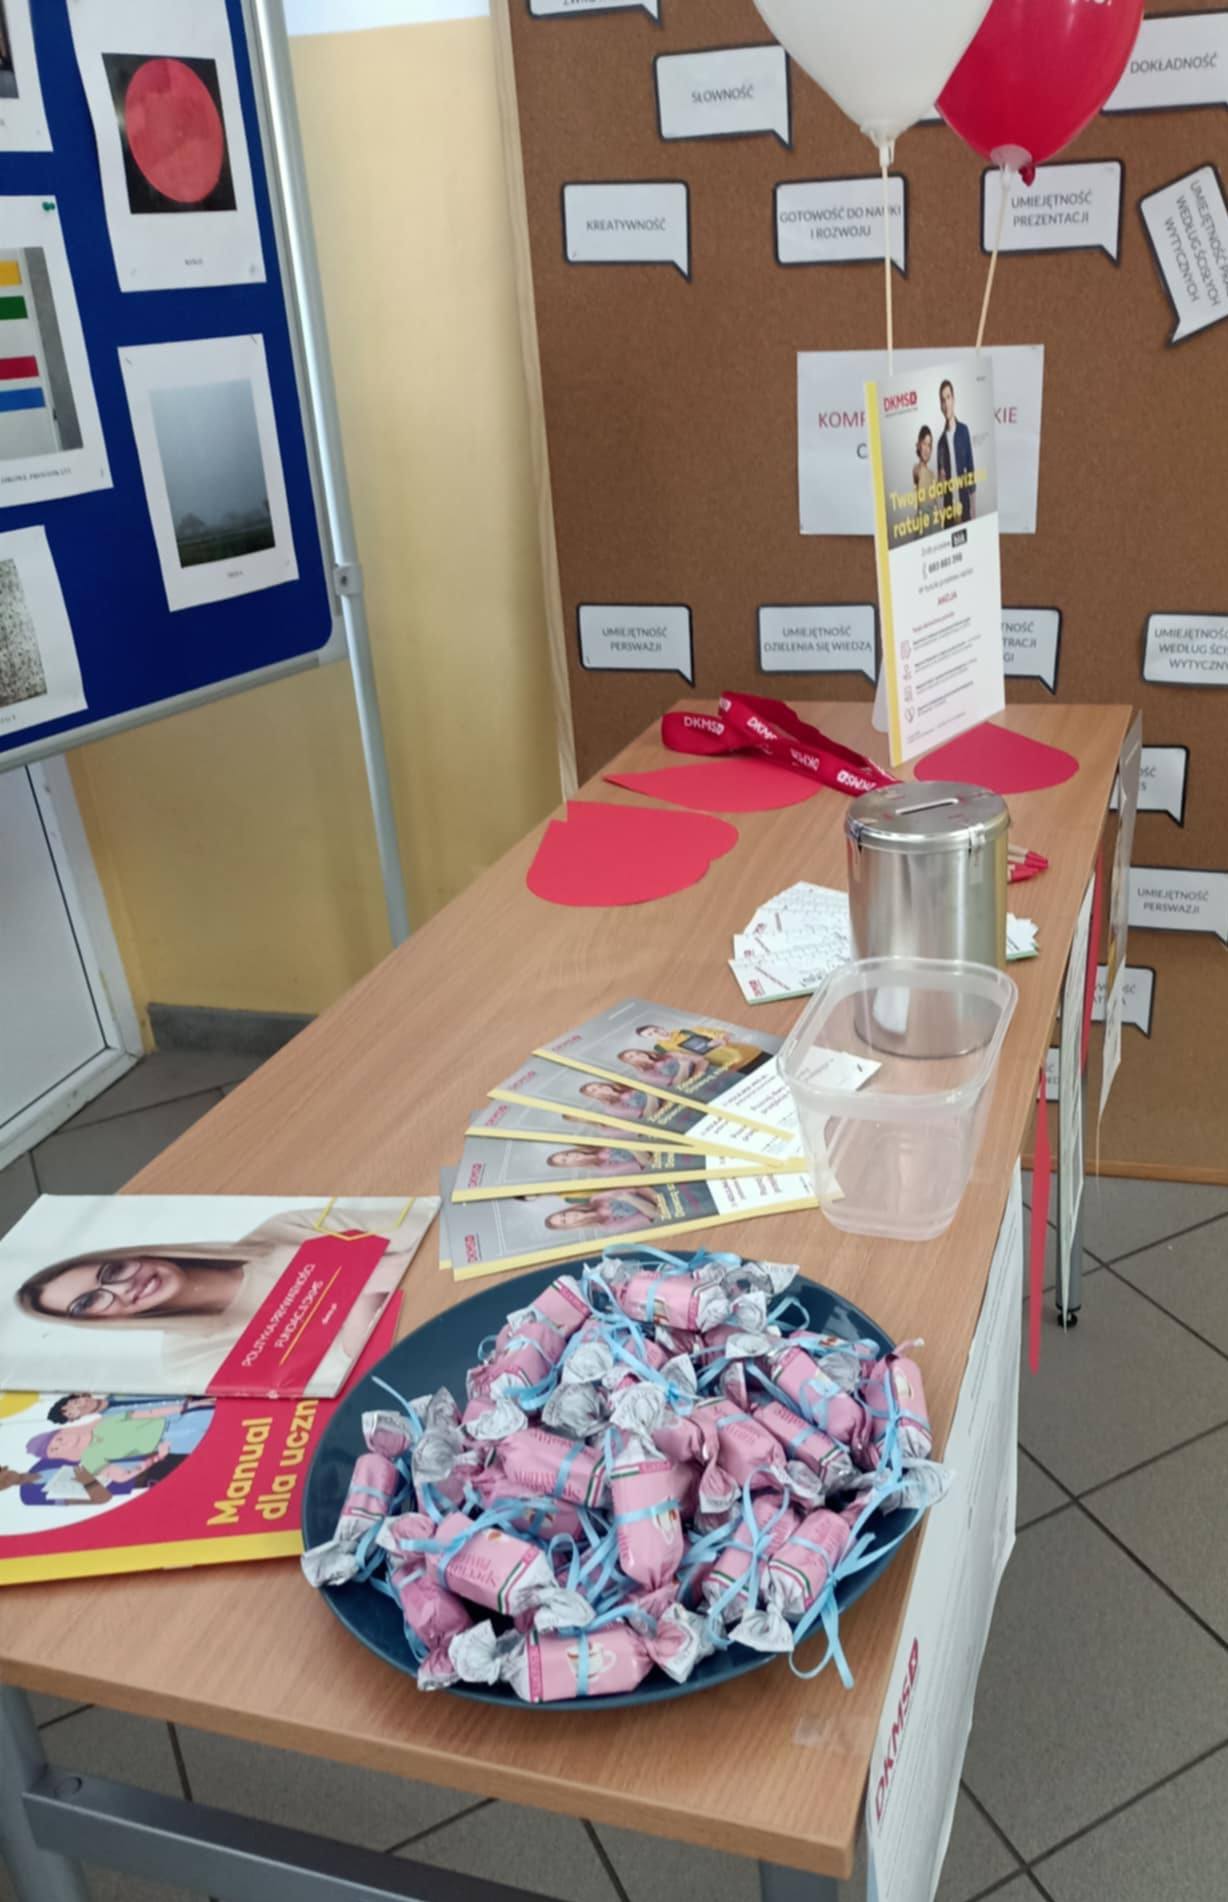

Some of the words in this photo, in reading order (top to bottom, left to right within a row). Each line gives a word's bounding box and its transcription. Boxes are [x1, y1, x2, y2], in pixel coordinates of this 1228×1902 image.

[1130, 52, 1217, 73] DOKŁADNOŚĆ
[691, 85, 754, 103] SŁOWNOŚĆ
[1011, 189, 1092, 209] UMIEJĘTNOŚĆ
[780, 205, 844, 223] GOTOWOŚĆ
[846, 207, 865, 219] DO
[1013, 211, 1089, 228] PREZENTACJI
[1190, 180, 1227, 265] UMIEJĘTNOŚĆ
[586, 216, 666, 232] KREATYWNOŚĆ
[816, 225, 871, 239] ROZWOJU
[1164, 216, 1200, 303] WYTYCZNYCH
[1176, 195, 1202, 251] WEDŁUG
[1194, 249, 1221, 306] ŚCISŁYCH
[890, 485, 926, 512] Twoja
[893, 509, 930, 538] ratuje
[932, 501, 963, 532] życie
[602, 625, 668, 640] UMIEJĘTNOŚĆ
[782, 624, 851, 640] UMIEJĘTNOŚĆ
[610, 642, 662, 653] PERSWAZJI
[764, 641, 814, 653] DZIELENIA
[815, 641, 831, 653] SIĘ
[1159, 643, 1208, 656] WEDŁUG
[1137, 887, 1209, 903] UMIEJĘTNOŚĆ
[1143, 902, 1200, 914] PERSWAZJI
[206, 1417, 273, 1526] Manual
[255, 1473, 298, 1520] dla
